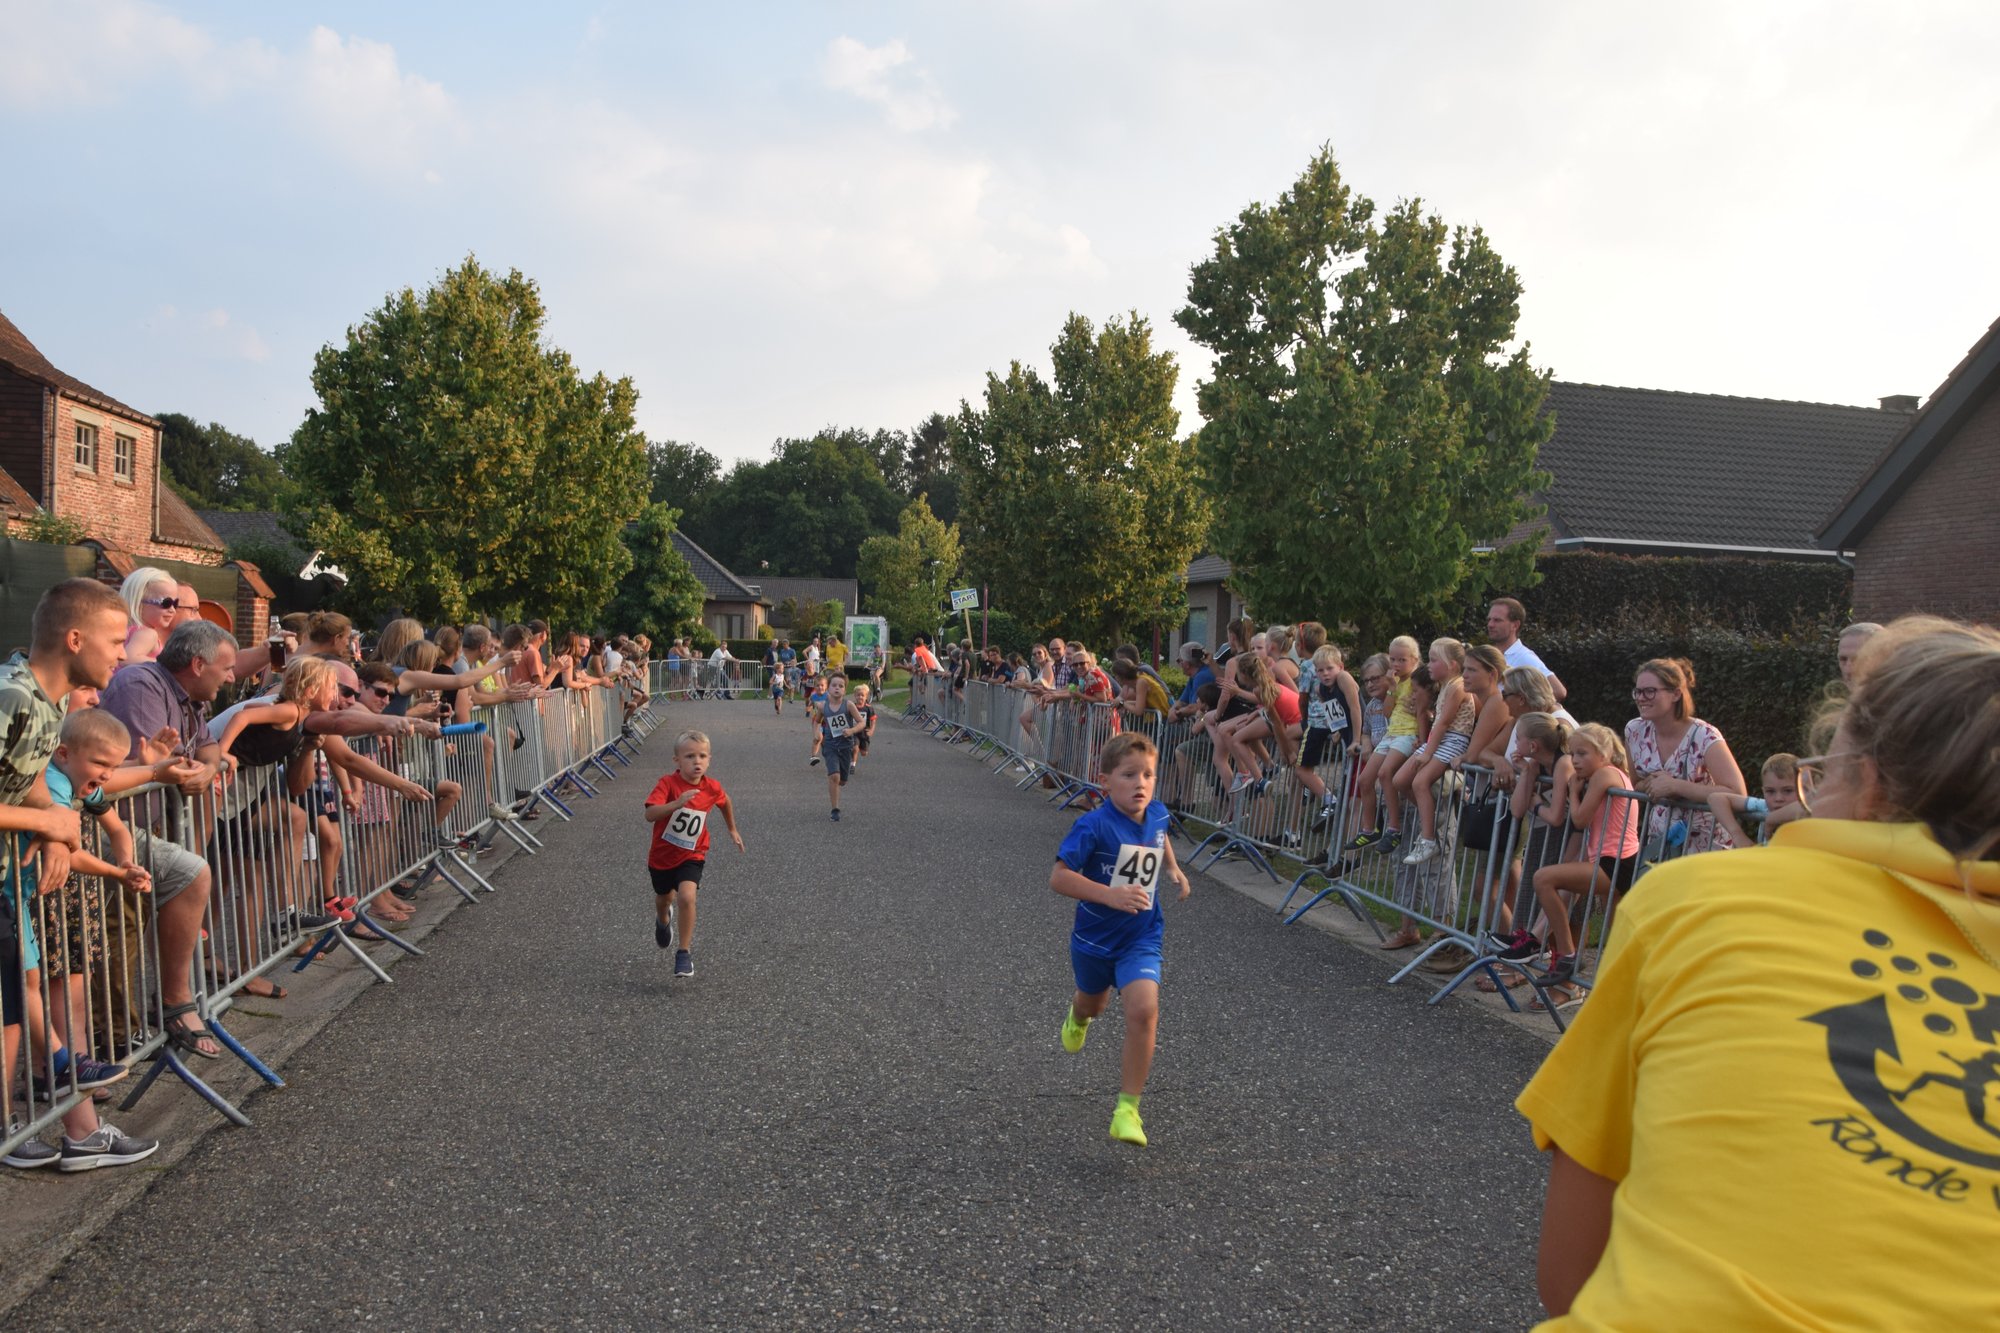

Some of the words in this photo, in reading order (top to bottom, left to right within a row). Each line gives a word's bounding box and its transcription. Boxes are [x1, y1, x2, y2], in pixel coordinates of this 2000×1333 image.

[953, 593, 977, 606] START
[1325, 701, 1345, 720] 143
[831, 715, 846, 729] 48
[672, 812, 701, 837] 50
[1118, 850, 1157, 887] 49
[1809, 1114, 1970, 1202] Ronde
